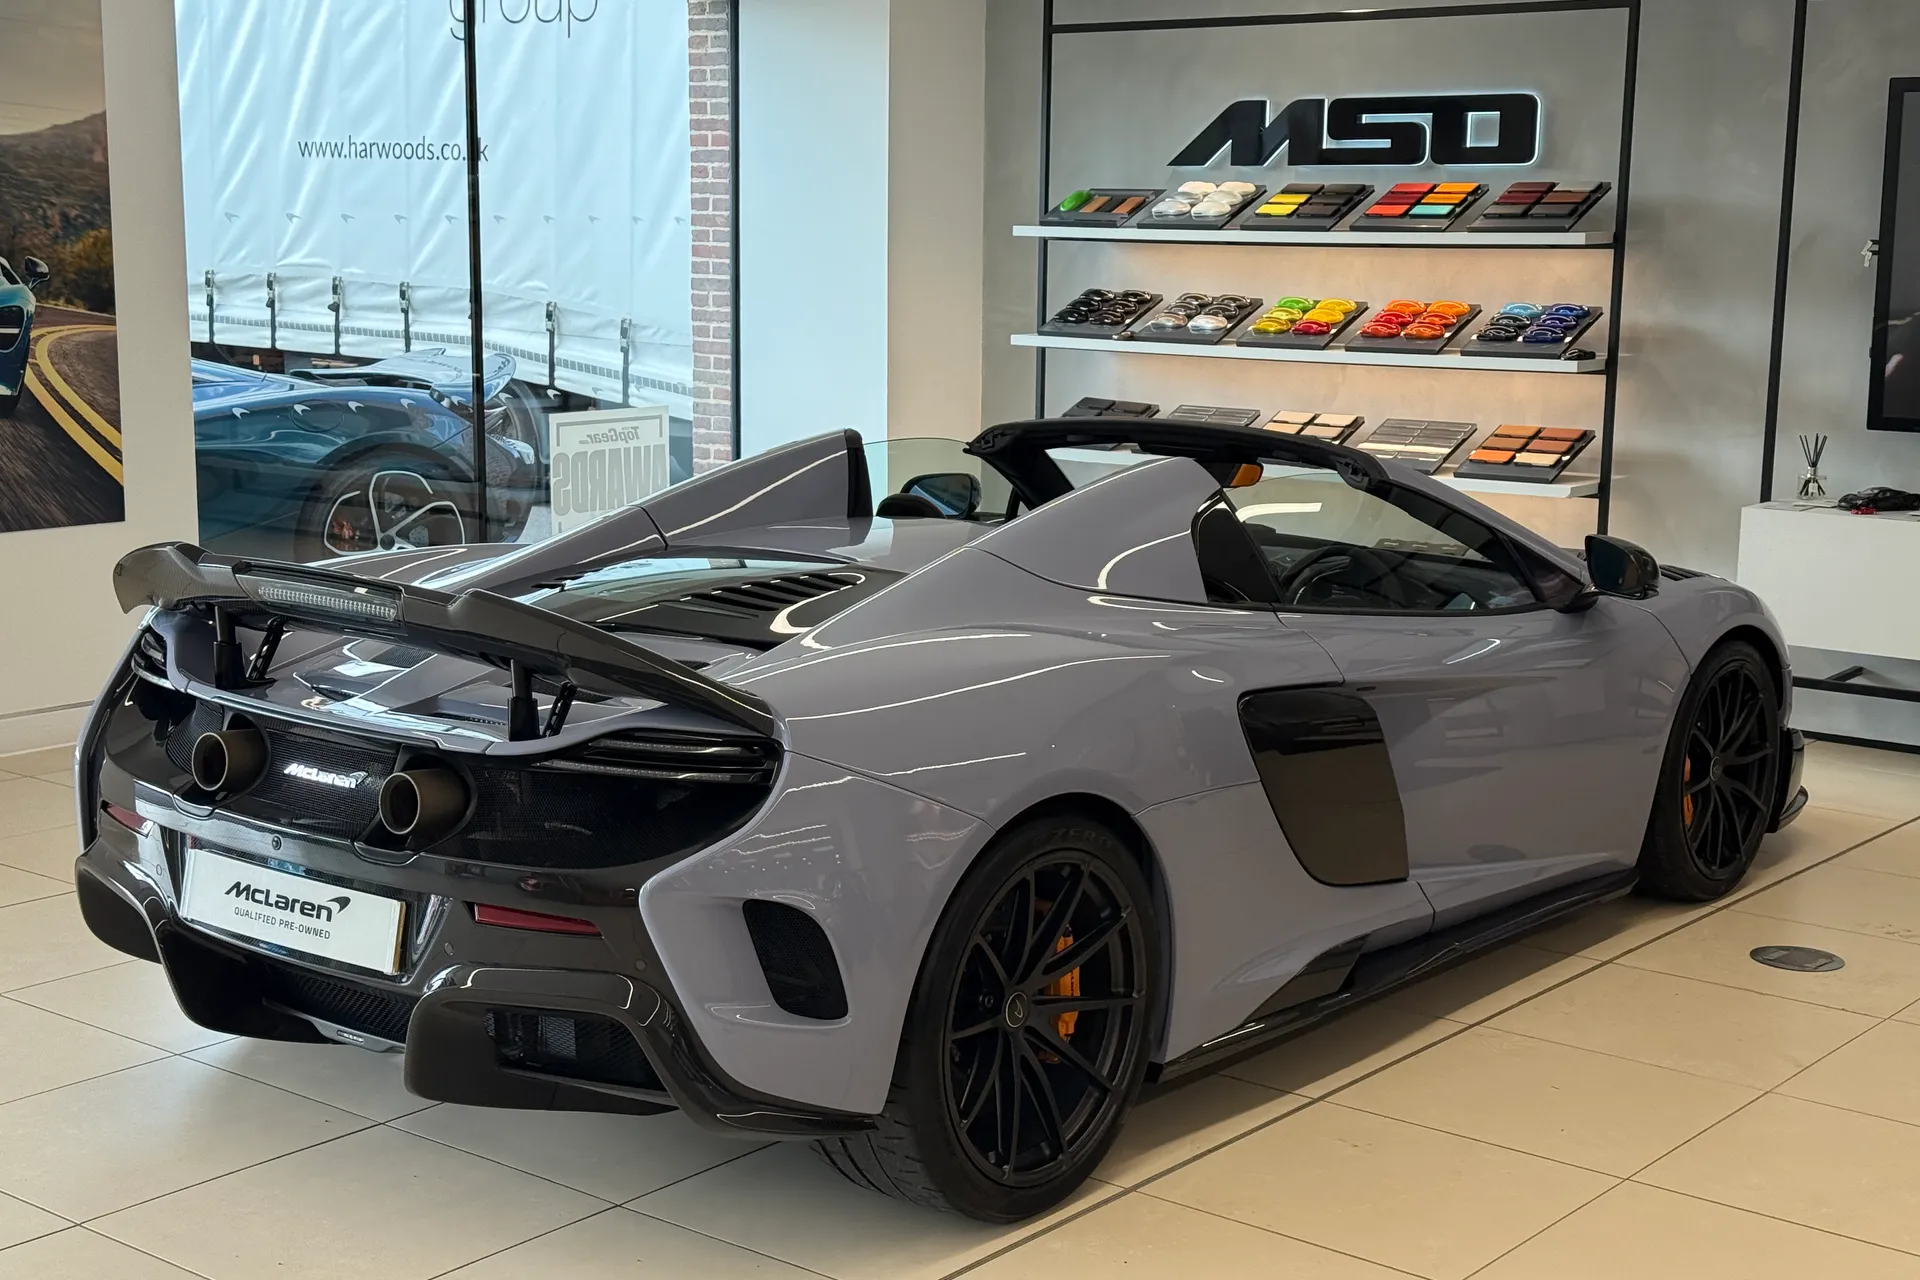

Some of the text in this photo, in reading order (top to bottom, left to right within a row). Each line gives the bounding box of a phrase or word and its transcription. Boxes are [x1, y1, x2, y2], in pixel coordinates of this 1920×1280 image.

[1167, 93, 1540, 167] MSO
[298, 136, 489, 162] www.harwoods.co.k
[284, 763, 356, 789] McLaren
[224, 881, 333, 923] McLaren
[234, 906, 331, 940] QUALIFIED PRE-OWNED
